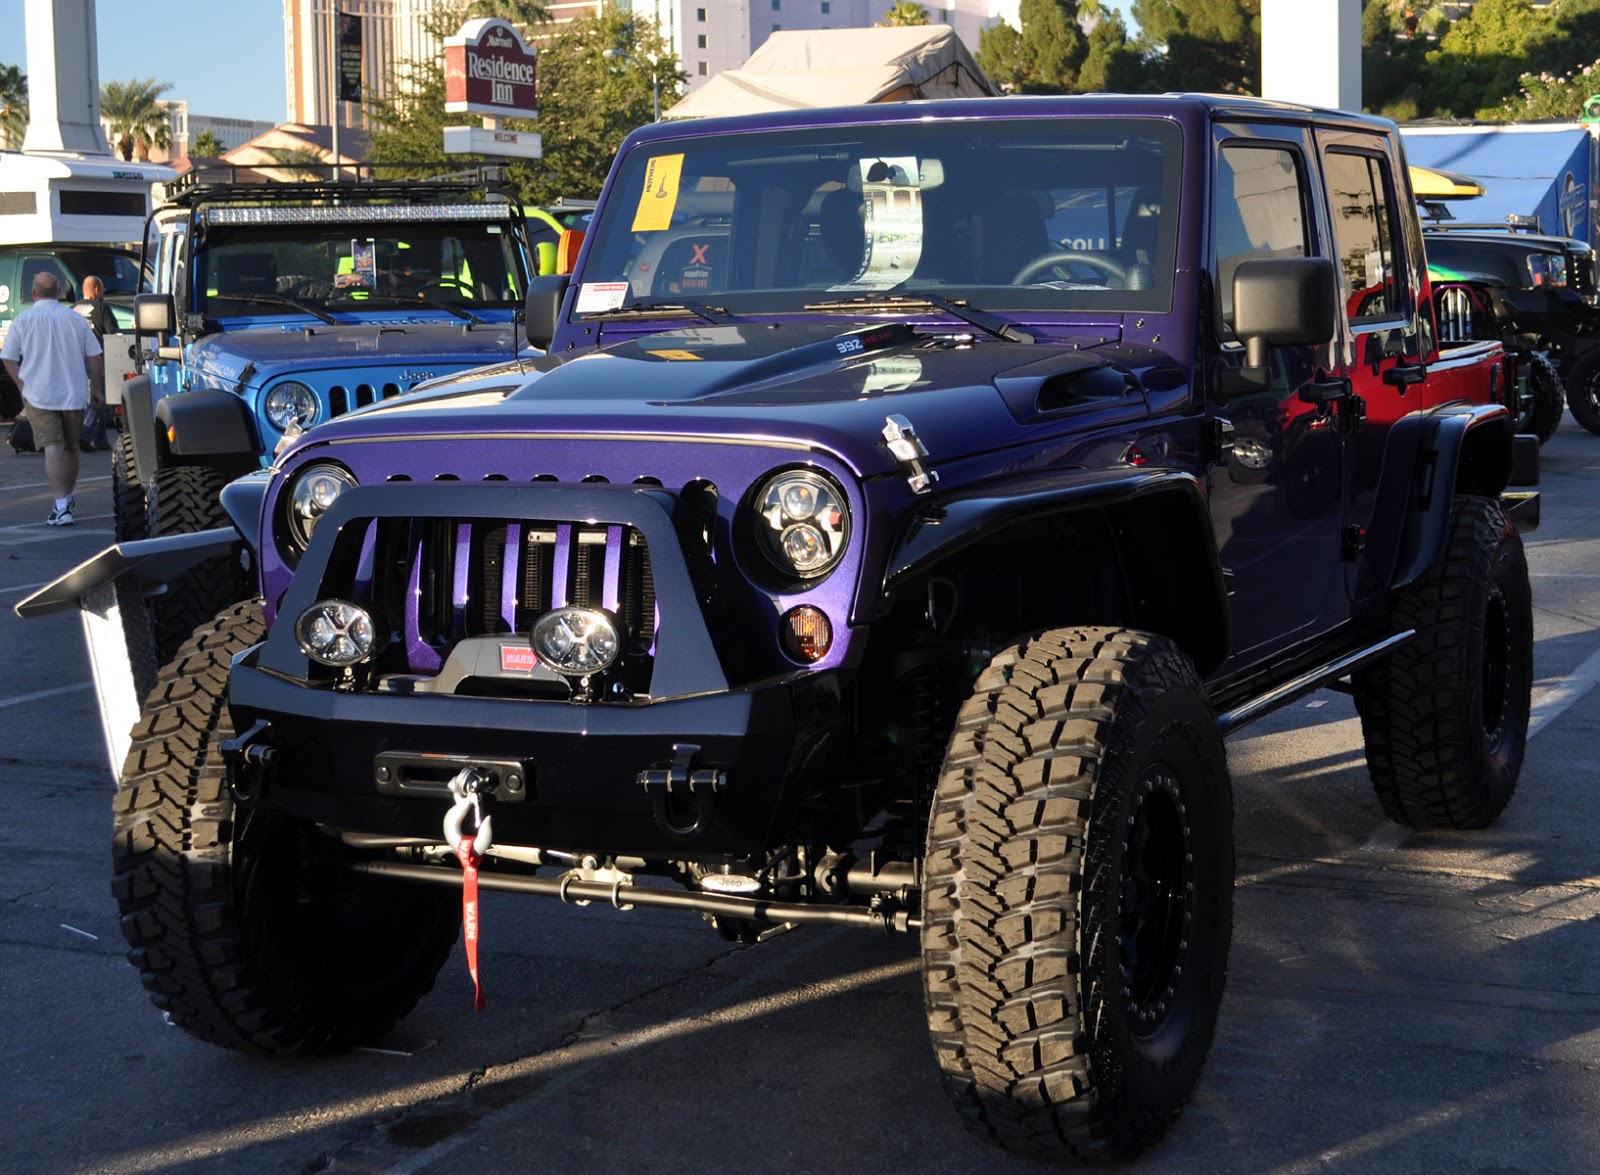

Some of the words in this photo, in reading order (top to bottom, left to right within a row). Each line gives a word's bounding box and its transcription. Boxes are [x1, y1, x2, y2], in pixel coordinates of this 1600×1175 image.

[468, 52, 533, 82] Residence
[491, 80, 514, 102] Inn
[494, 132, 518, 143] WELCOME
[645, 159, 656, 192] MOTHERS
[836, 339, 864, 354] 392
[399, 369, 436, 381] Jeep
[505, 654, 534, 664] WARN
[719, 877, 743, 887] Jeep
[465, 901, 476, 940] WARN
